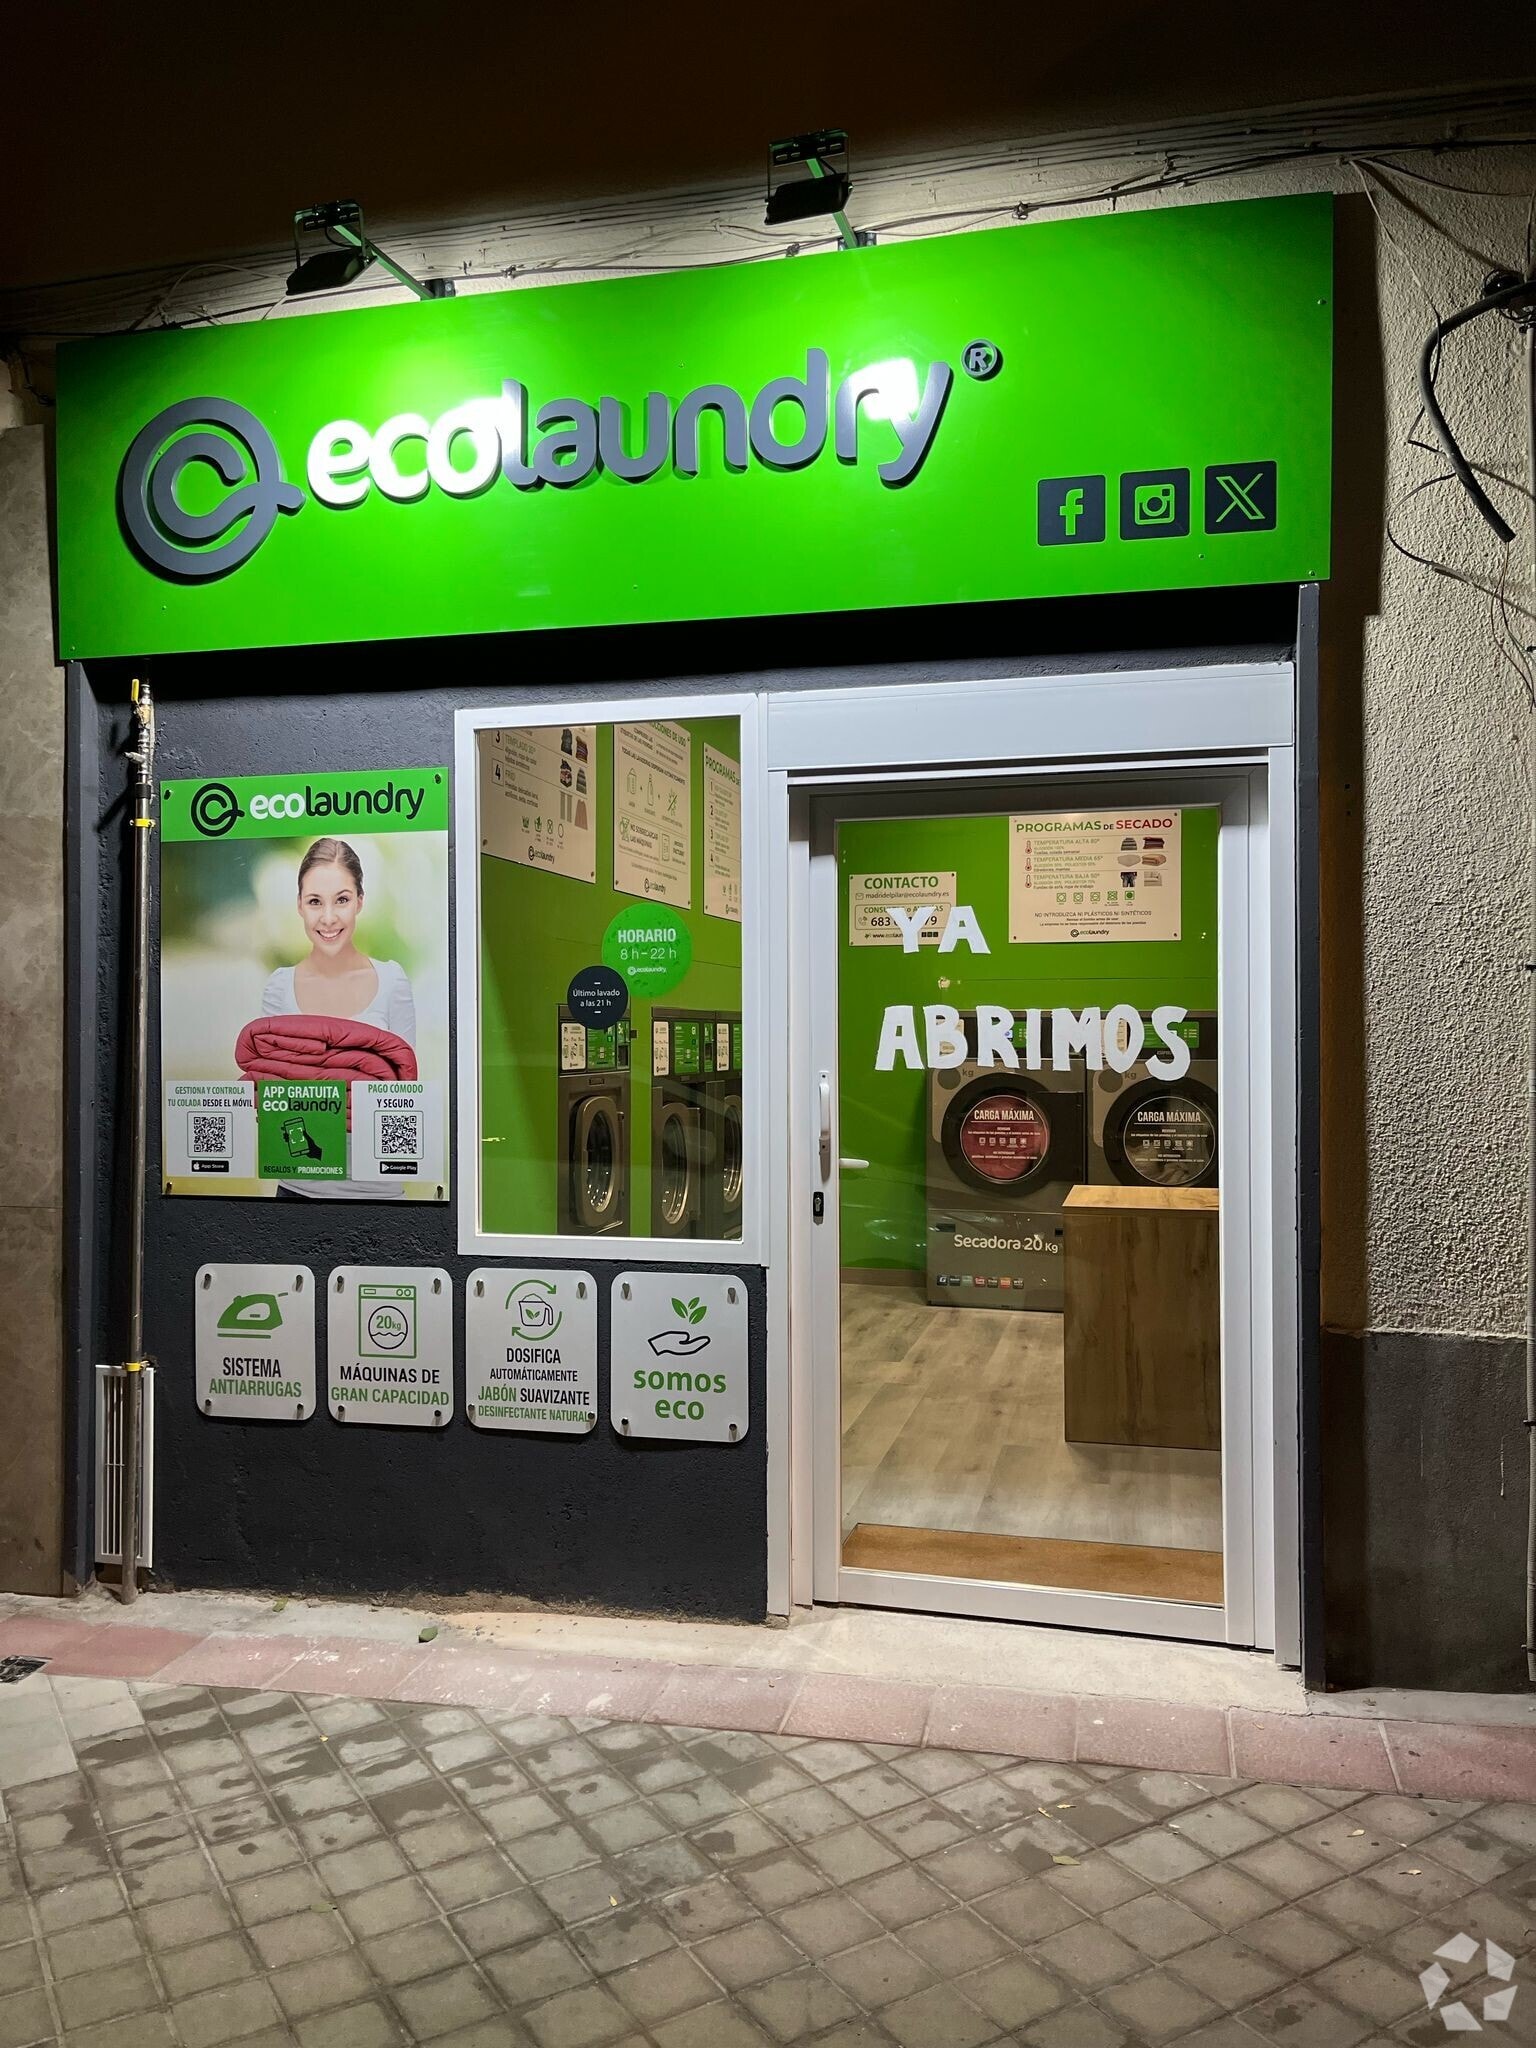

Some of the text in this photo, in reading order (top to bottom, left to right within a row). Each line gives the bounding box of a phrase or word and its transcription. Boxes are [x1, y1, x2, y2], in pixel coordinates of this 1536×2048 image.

[307, 347, 952, 507] ecolaundry
[495, 764, 501, 781] 4
[250, 782, 425, 820] ecolaundry
[1016, 818, 1173, 833] PROGRAMAS DE SECADO
[864, 876, 939, 889] CONTACTO
[1120, 909, 1152, 917] SINTÉTICOS
[871, 917, 891, 927] 683
[886, 905, 991, 954] YA
[618, 928, 677, 943] HORARIO
[1080, 928, 1110, 936] ecolaundry
[620, 948, 628, 960] 8
[573, 989, 621, 997] Último lavado
[585, 999, 596, 1007] las
[875, 1004, 1191, 1082] ABRIMOS
[175, 1086, 206, 1095] GESTIONA
[212, 1086, 245, 1095] CONTROLA
[263, 1086, 340, 1099] APP GRATUITA
[368, 1083, 424, 1094] PAGO CÓMODO
[168, 1098, 253, 1108] TU COLADA DESDE EL MÓVIL
[262, 1098, 342, 1114] ecolaundry
[376, 1098, 414, 1109] Y SEGURO
[974, 1107, 1034, 1121] CARGA MÁXIMA
[1137, 1109, 1201, 1123] CARGA MÁXIMA
[297, 1166, 343, 1175] PROMOCIONES
[954, 1234, 1059, 1254] Secadora 20 Kg
[506, 1348, 561, 1364] DOSIFICA
[223, 1357, 282, 1378] SISTEMA
[340, 1363, 440, 1384] MÁQUINAS DE
[489, 1367, 578, 1382] AUTOMÁTICAMENTE
[209, 1378, 302, 1398] ANTIARRUGAS
[633, 1369, 727, 1394] somos
[331, 1387, 450, 1406] GRAN CAPACIDAD
[478, 1384, 590, 1406] JABÓN SUAVIZANTE
[478, 1405, 590, 1423] DESINFECTANTE NATURAL
[654, 1399, 705, 1421] eco
